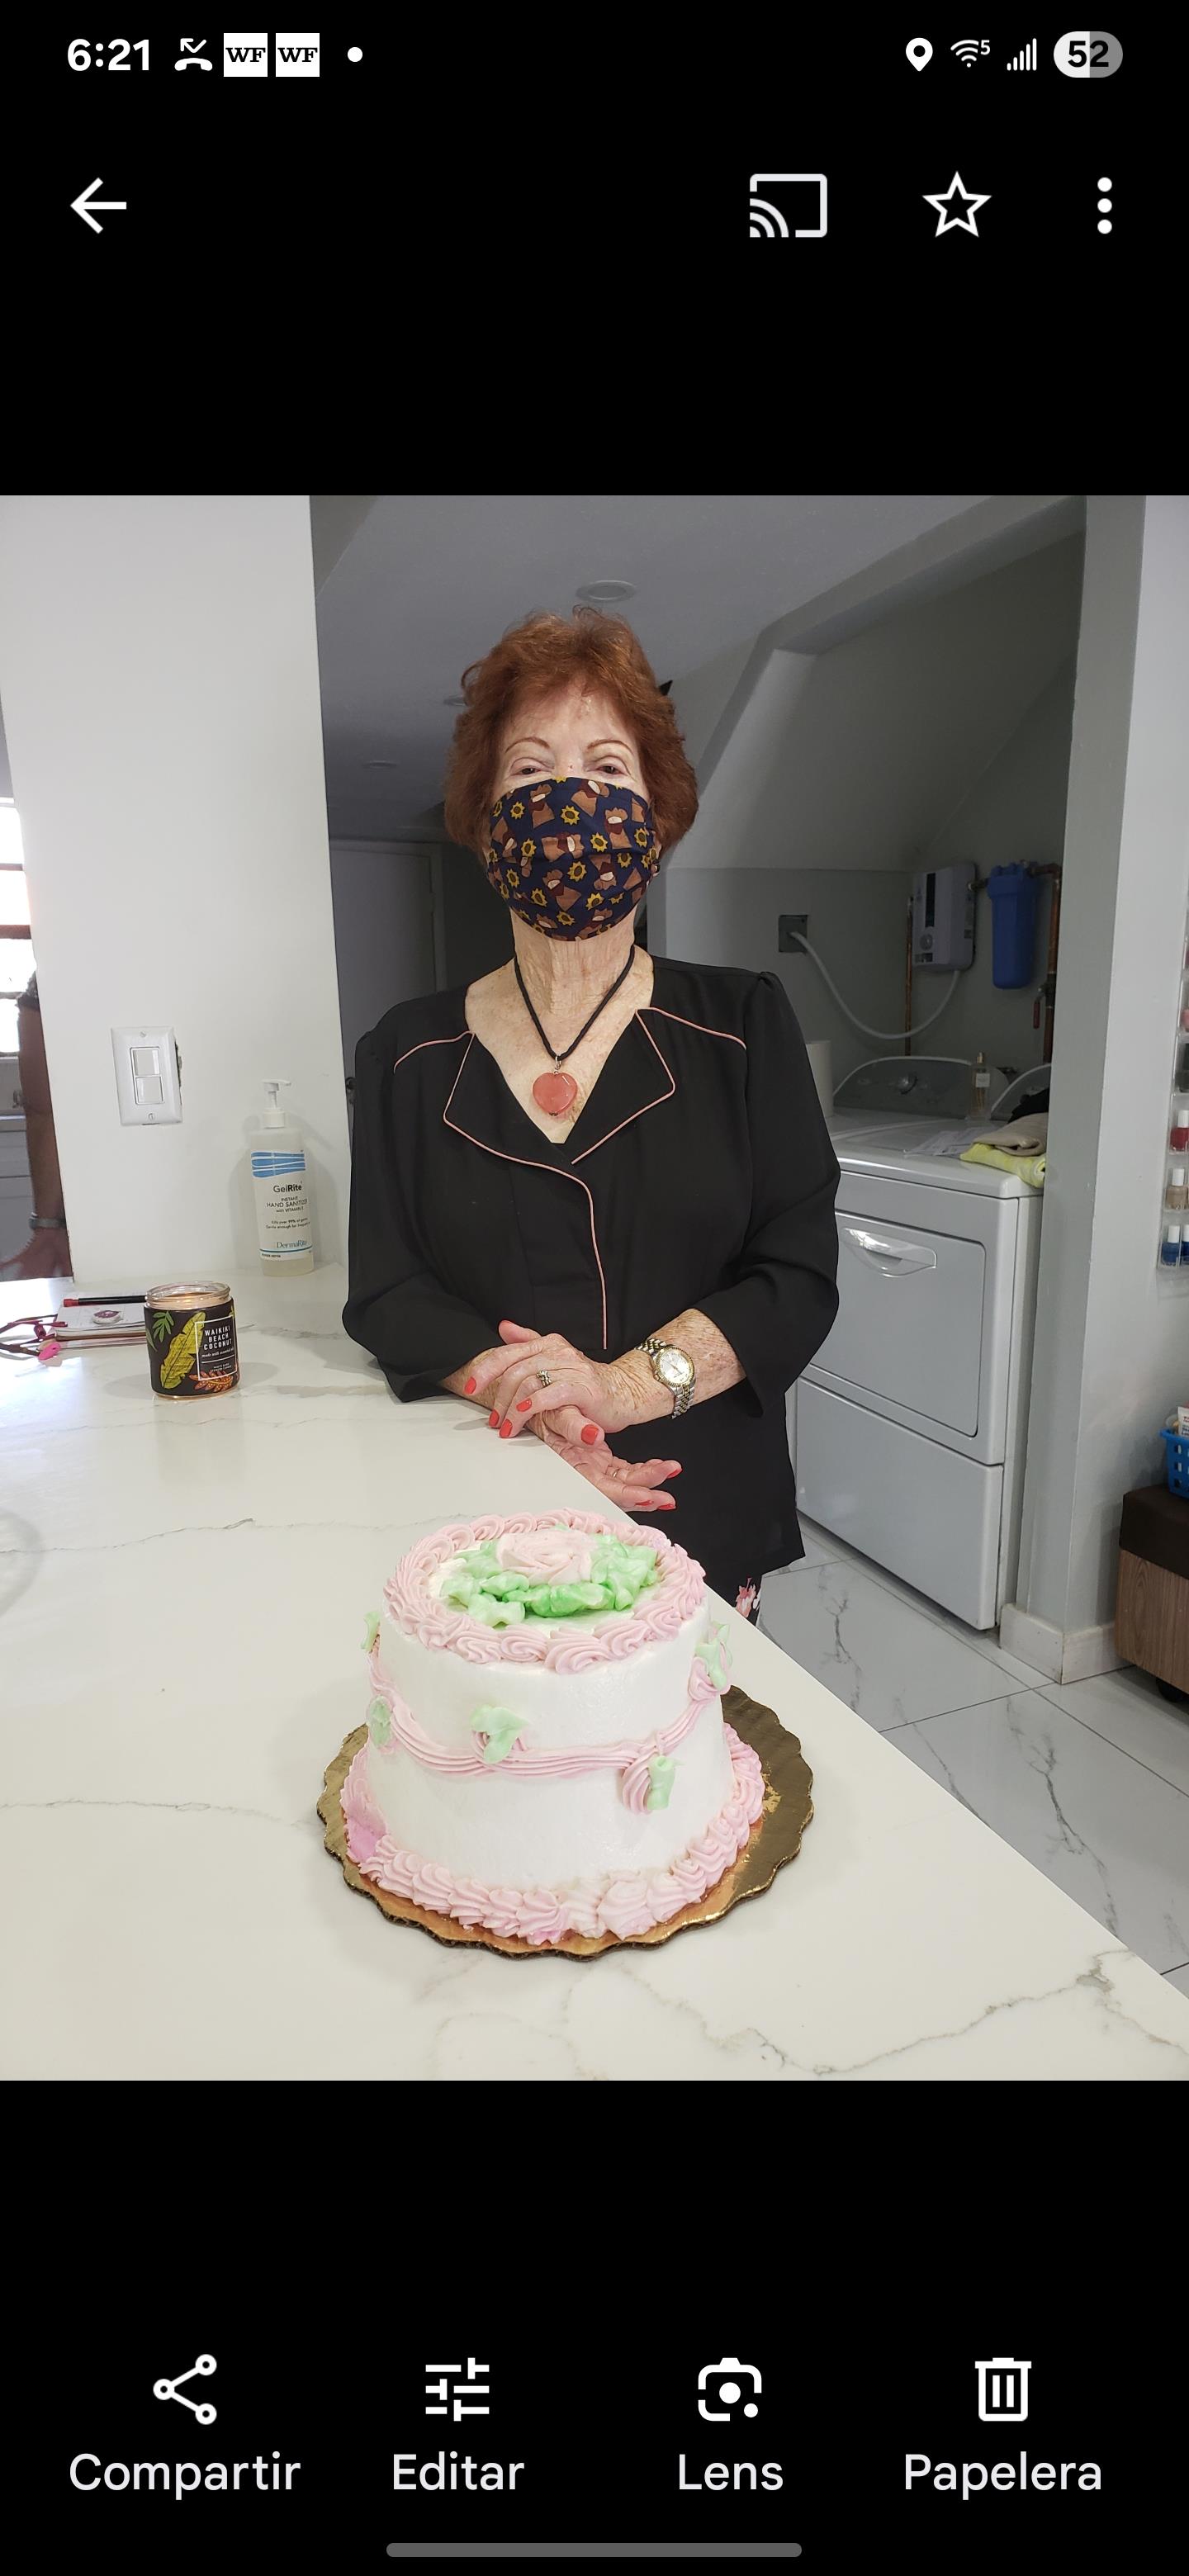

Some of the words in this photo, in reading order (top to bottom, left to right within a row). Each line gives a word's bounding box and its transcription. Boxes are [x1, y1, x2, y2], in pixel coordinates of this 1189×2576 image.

[273, 1184, 302, 1193] GelRite
[205, 1325, 230, 1336] WAIKIKI
[208, 1333, 229, 1342] BEACH
[204, 1338, 232, 1350] COCONUT
